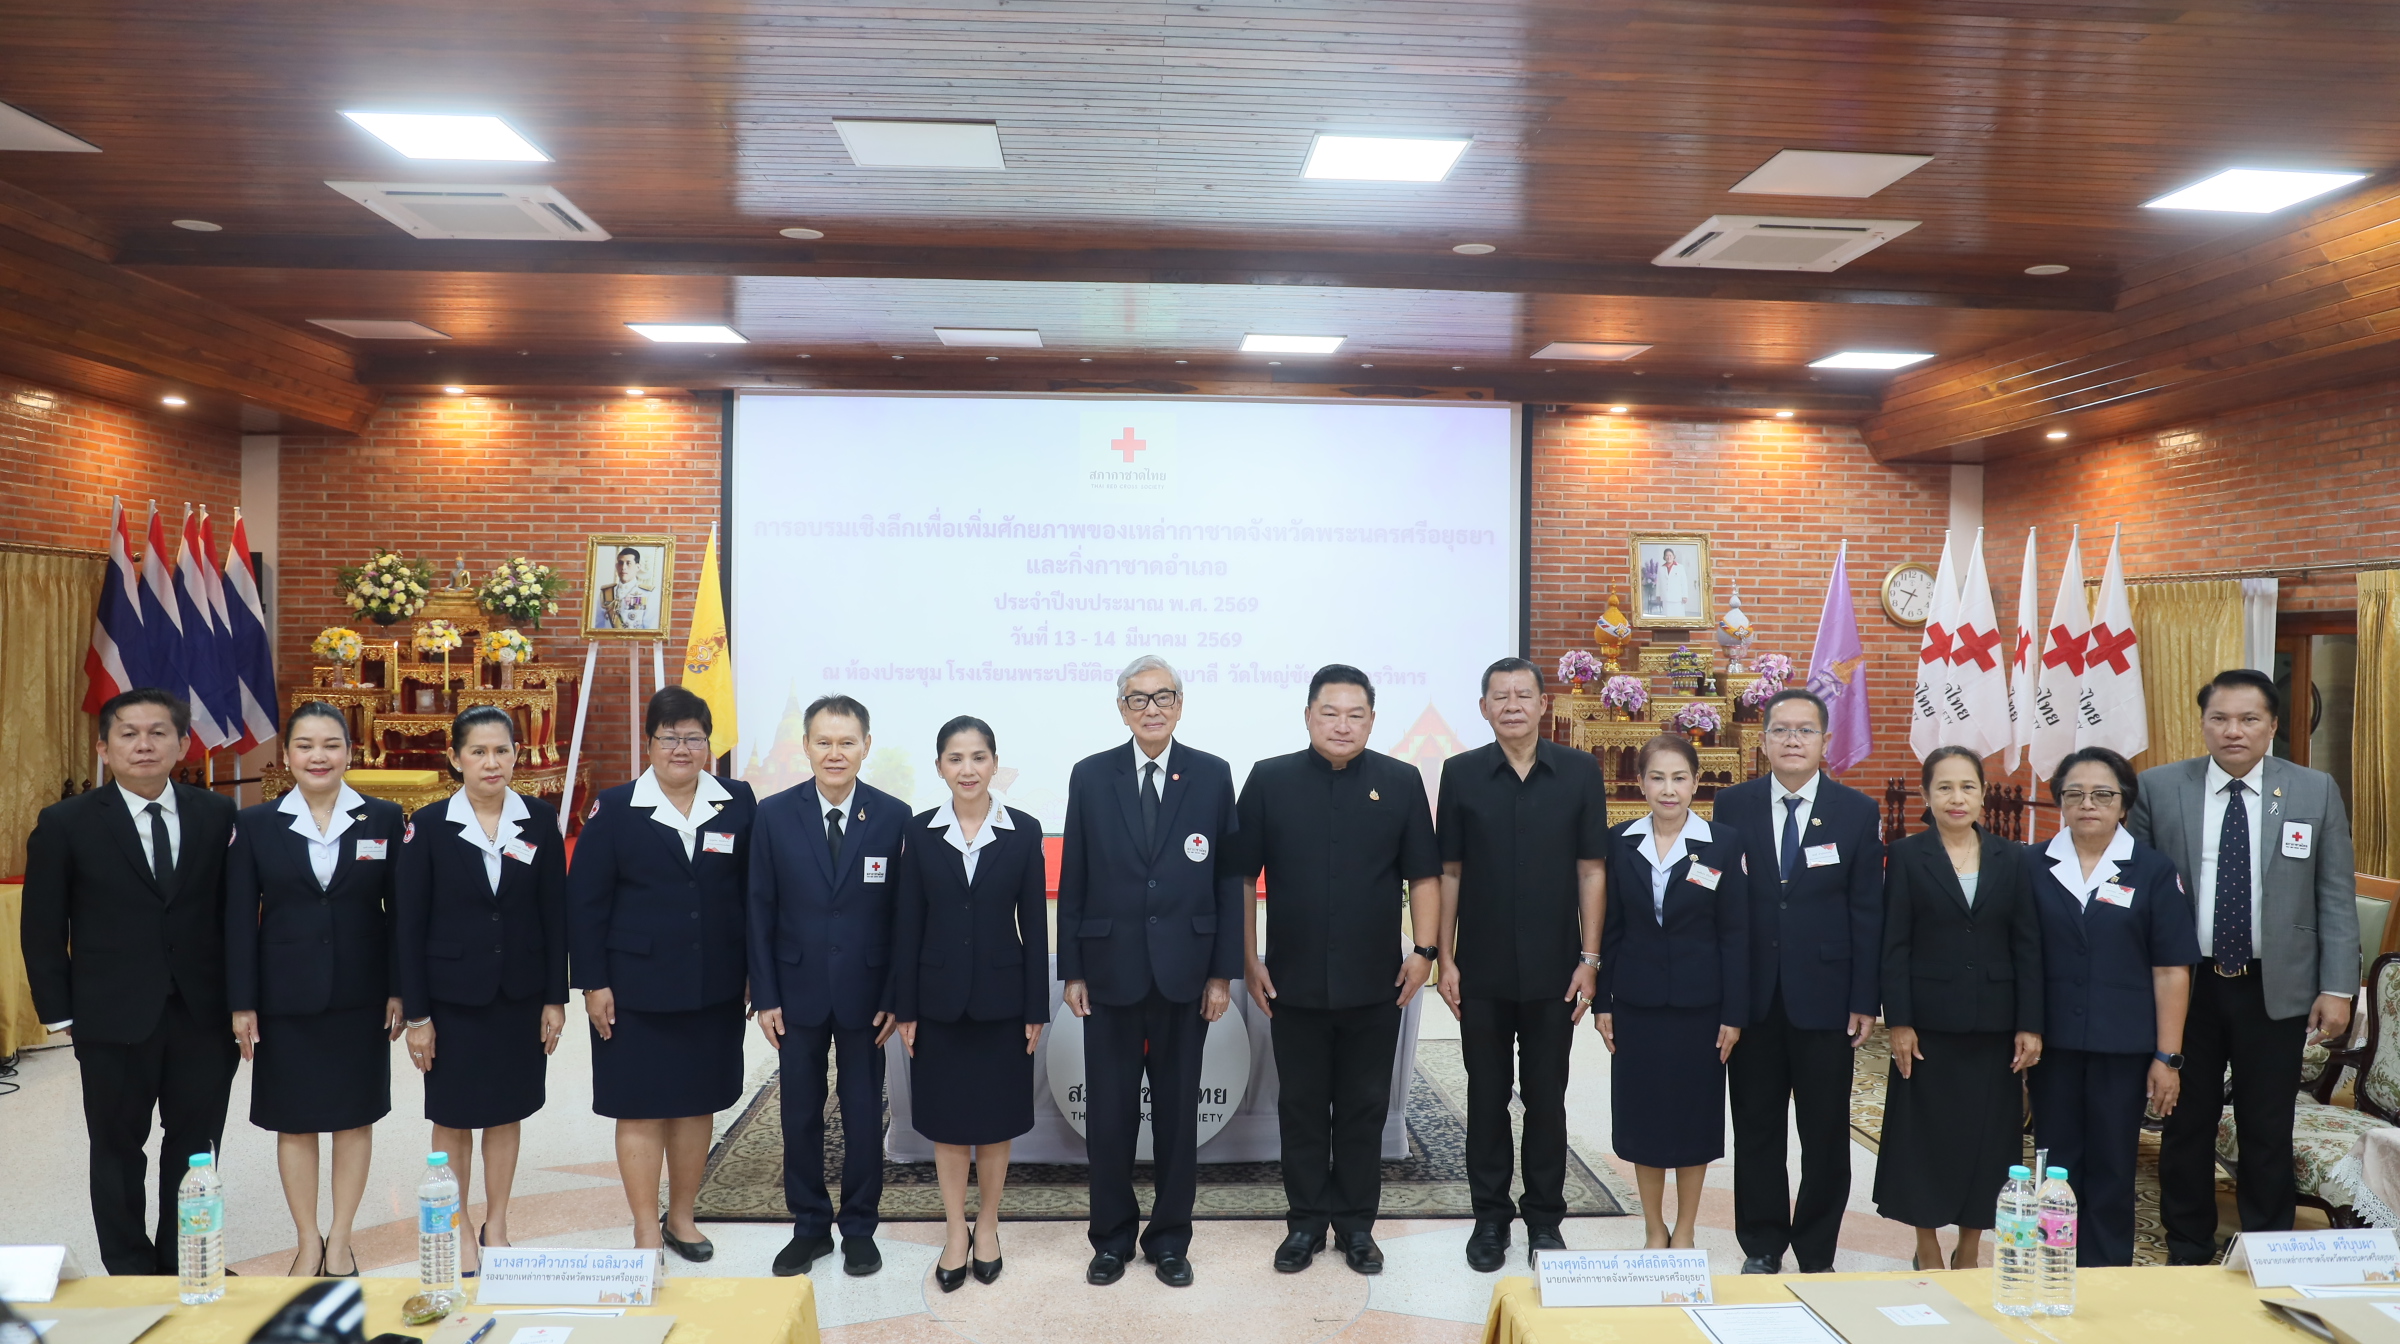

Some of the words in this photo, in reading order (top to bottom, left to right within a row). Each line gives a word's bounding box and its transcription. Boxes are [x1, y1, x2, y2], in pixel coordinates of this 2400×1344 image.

[1089, 467, 1167, 481] สภากาชาดไทย
[753, 507, 1496, 552] การอบรมเชิงลึกเพื่อเพิ่มศักยภาพของเหล่ากาชาดจังหวัดพระนครศรีอยุธยา
[1026, 545, 1228, 576] และกิ่งกาชาดอำเภอ
[1901, 573, 1907, 581] 11
[994, 590, 1164, 612] ประจำปีงบประมาณ
[1168, 598, 1208, 613] พ.ศ.
[1213, 596, 1259, 613] 2569
[1010, 620, 1048, 647] วันที่
[1054, 630, 1077, 647] 13
[1094, 631, 1117, 647] 14
[1125, 626, 1187, 648] มีนาคม
[1197, 632, 1243, 648] 2569
[822, 665, 841, 680] ณ
[845, 659, 942, 688] ห้องประชุม
[493, 1254, 588, 1269] นางสาวศิวาภรณ์
[592, 1254, 645, 1269] เฉลิมวงศ์
[1541, 1254, 1619, 1274] นางศุทธิกานต์
[1622, 1254, 1706, 1270] วงศ์สถิตจิรกาล
[1545, 1272, 1706, 1285] นายกเหล่ากาชาดจังหวัดพระนครศรีอยุธยา
